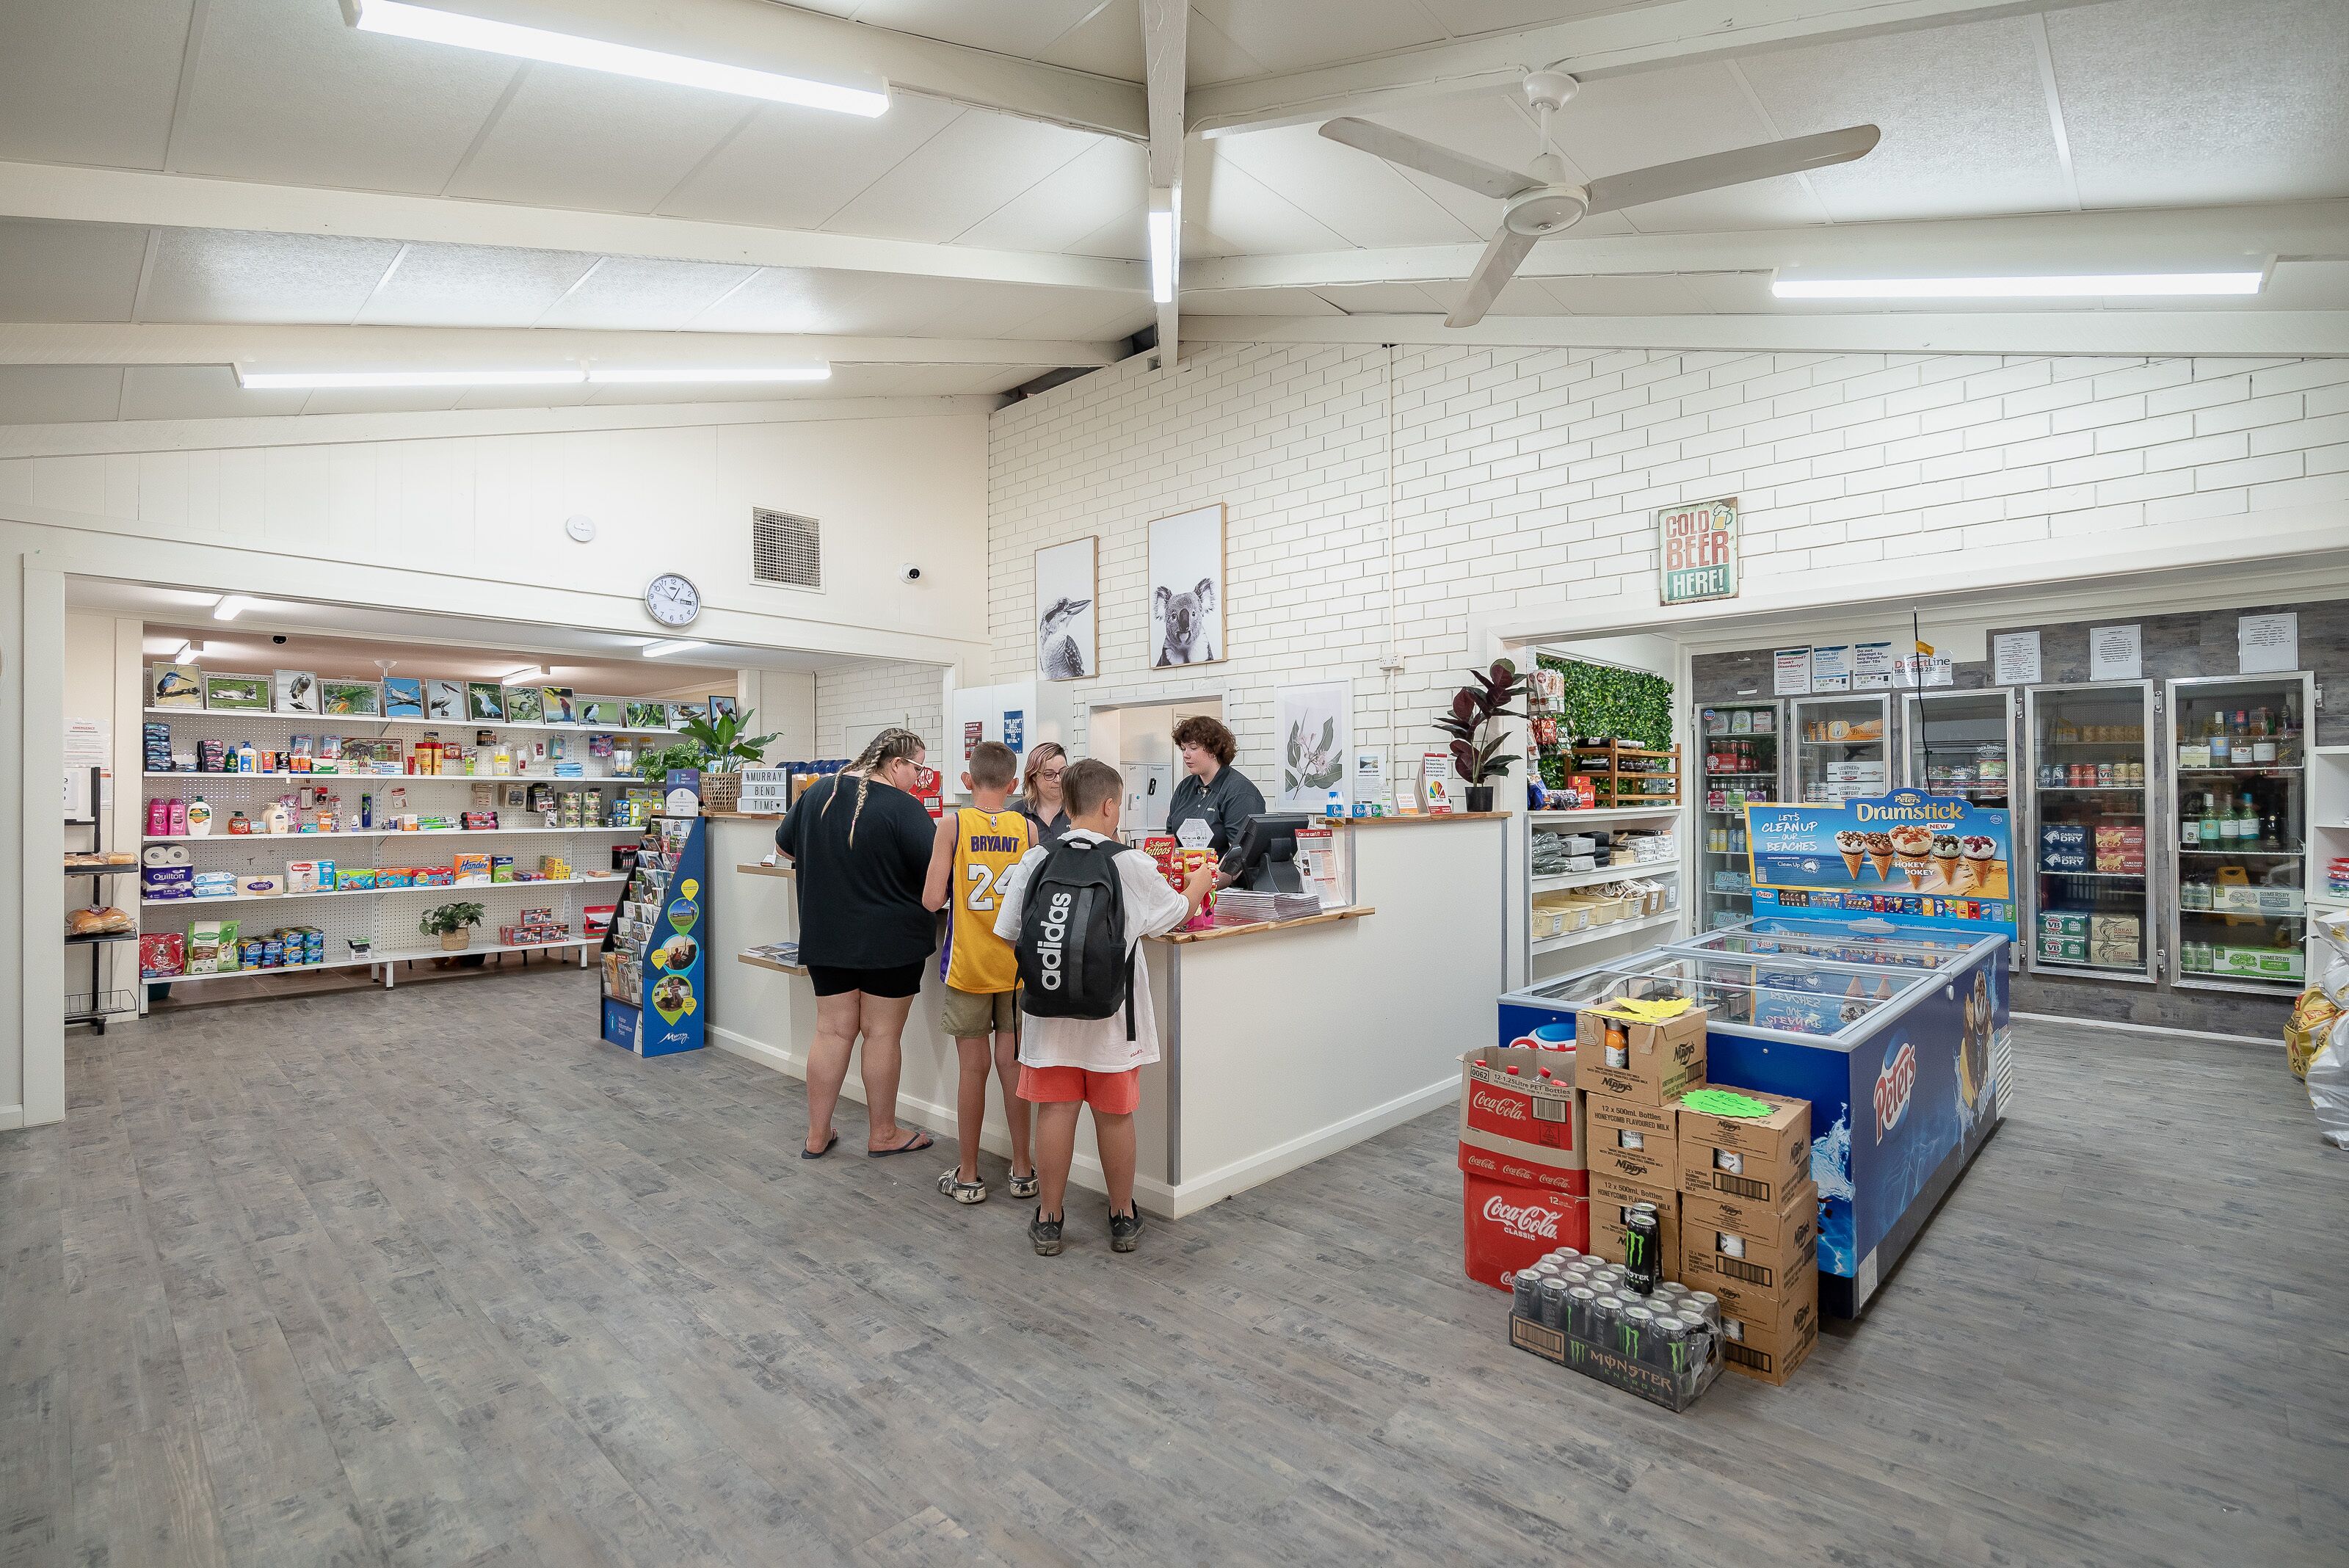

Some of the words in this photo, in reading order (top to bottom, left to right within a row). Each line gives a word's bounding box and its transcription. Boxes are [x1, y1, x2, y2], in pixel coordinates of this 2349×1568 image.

[1666, 510, 1710, 538] COLD
[1666, 531, 1729, 571] BEER
[1673, 568, 1724, 598] HERE!
[746, 772, 783, 781] #MURRAY
[755, 786, 775, 796] BEND
[754, 801, 774, 810] TIME
[1895, 795, 1920, 804] Peters
[1779, 812, 1801, 821] LET'S
[1856, 802, 1964, 822] Drumstick
[1761, 821, 1799, 832] CLEAN
[1801, 821, 1818, 832] UP
[1782, 832, 1801, 841] OUR
[970, 835, 1020, 853] BRYANT
[1765, 841, 1818, 852] BEACHES
[1144, 846, 1172, 857] Tattoos
[459, 860, 487, 873] Handee
[153, 873, 184, 881] Quilton
[1721, 874, 1737, 882] UDL
[967, 863, 1020, 911] 24
[1037, 893, 1072, 991] adidas
[658, 1032, 688, 1045] Murray
[1472, 1069, 1488, 1080] 0062
[1494, 1074, 1529, 1089] 12-1.25Litre
[1544, 1086, 1571, 1095] Bottles
[1601, 1076, 1633, 1093] Nippy's
[1876, 1045, 1916, 1141] Peters
[1473, 1091, 1525, 1121] Coca-Cola
[1594, 1111, 1625, 1123] HONEYCOMB
[1626, 1117, 1655, 1128] FLAVOURED
[1656, 1123, 1670, 1131] MILK
[1616, 1108, 1637, 1117] 500mL
[1638, 1111, 1662, 1121] Bottles
[1717, 1120, 1742, 1131] Nippy's
[1468, 1155, 1496, 1170] Coca-Cola
[1615, 1159, 1648, 1176] Nippy's
[1503, 1164, 1534, 1180] Coca-Cola
[1539, 1174, 1571, 1188] Coca-Cola
[1685, 1177, 1712, 1187] HONEYCOMB
[1685, 1181, 1710, 1191] FLAVOURED
[1619, 1184, 1639, 1194] 500mL
[1641, 1189, 1663, 1201] Bottles
[1549, 1196, 1559, 1205] 12
[1597, 1188, 1627, 1201] HONEYCOMB
[1657, 1202, 1671, 1212] MILK
[1718, 1204, 1743, 1216] Nippy's
[1483, 1195, 1564, 1240] Coca-Cola
[1503, 1227, 1536, 1241] CLASSIC
[1688, 1258, 1715, 1270] HONEYCOMB
[1688, 1263, 1713, 1274] FLAVOURED
[1718, 1287, 1741, 1300] Nippy's
[1590, 1350, 1674, 1395] MONSTER
[1604, 1368, 1658, 1393] ENERGY
